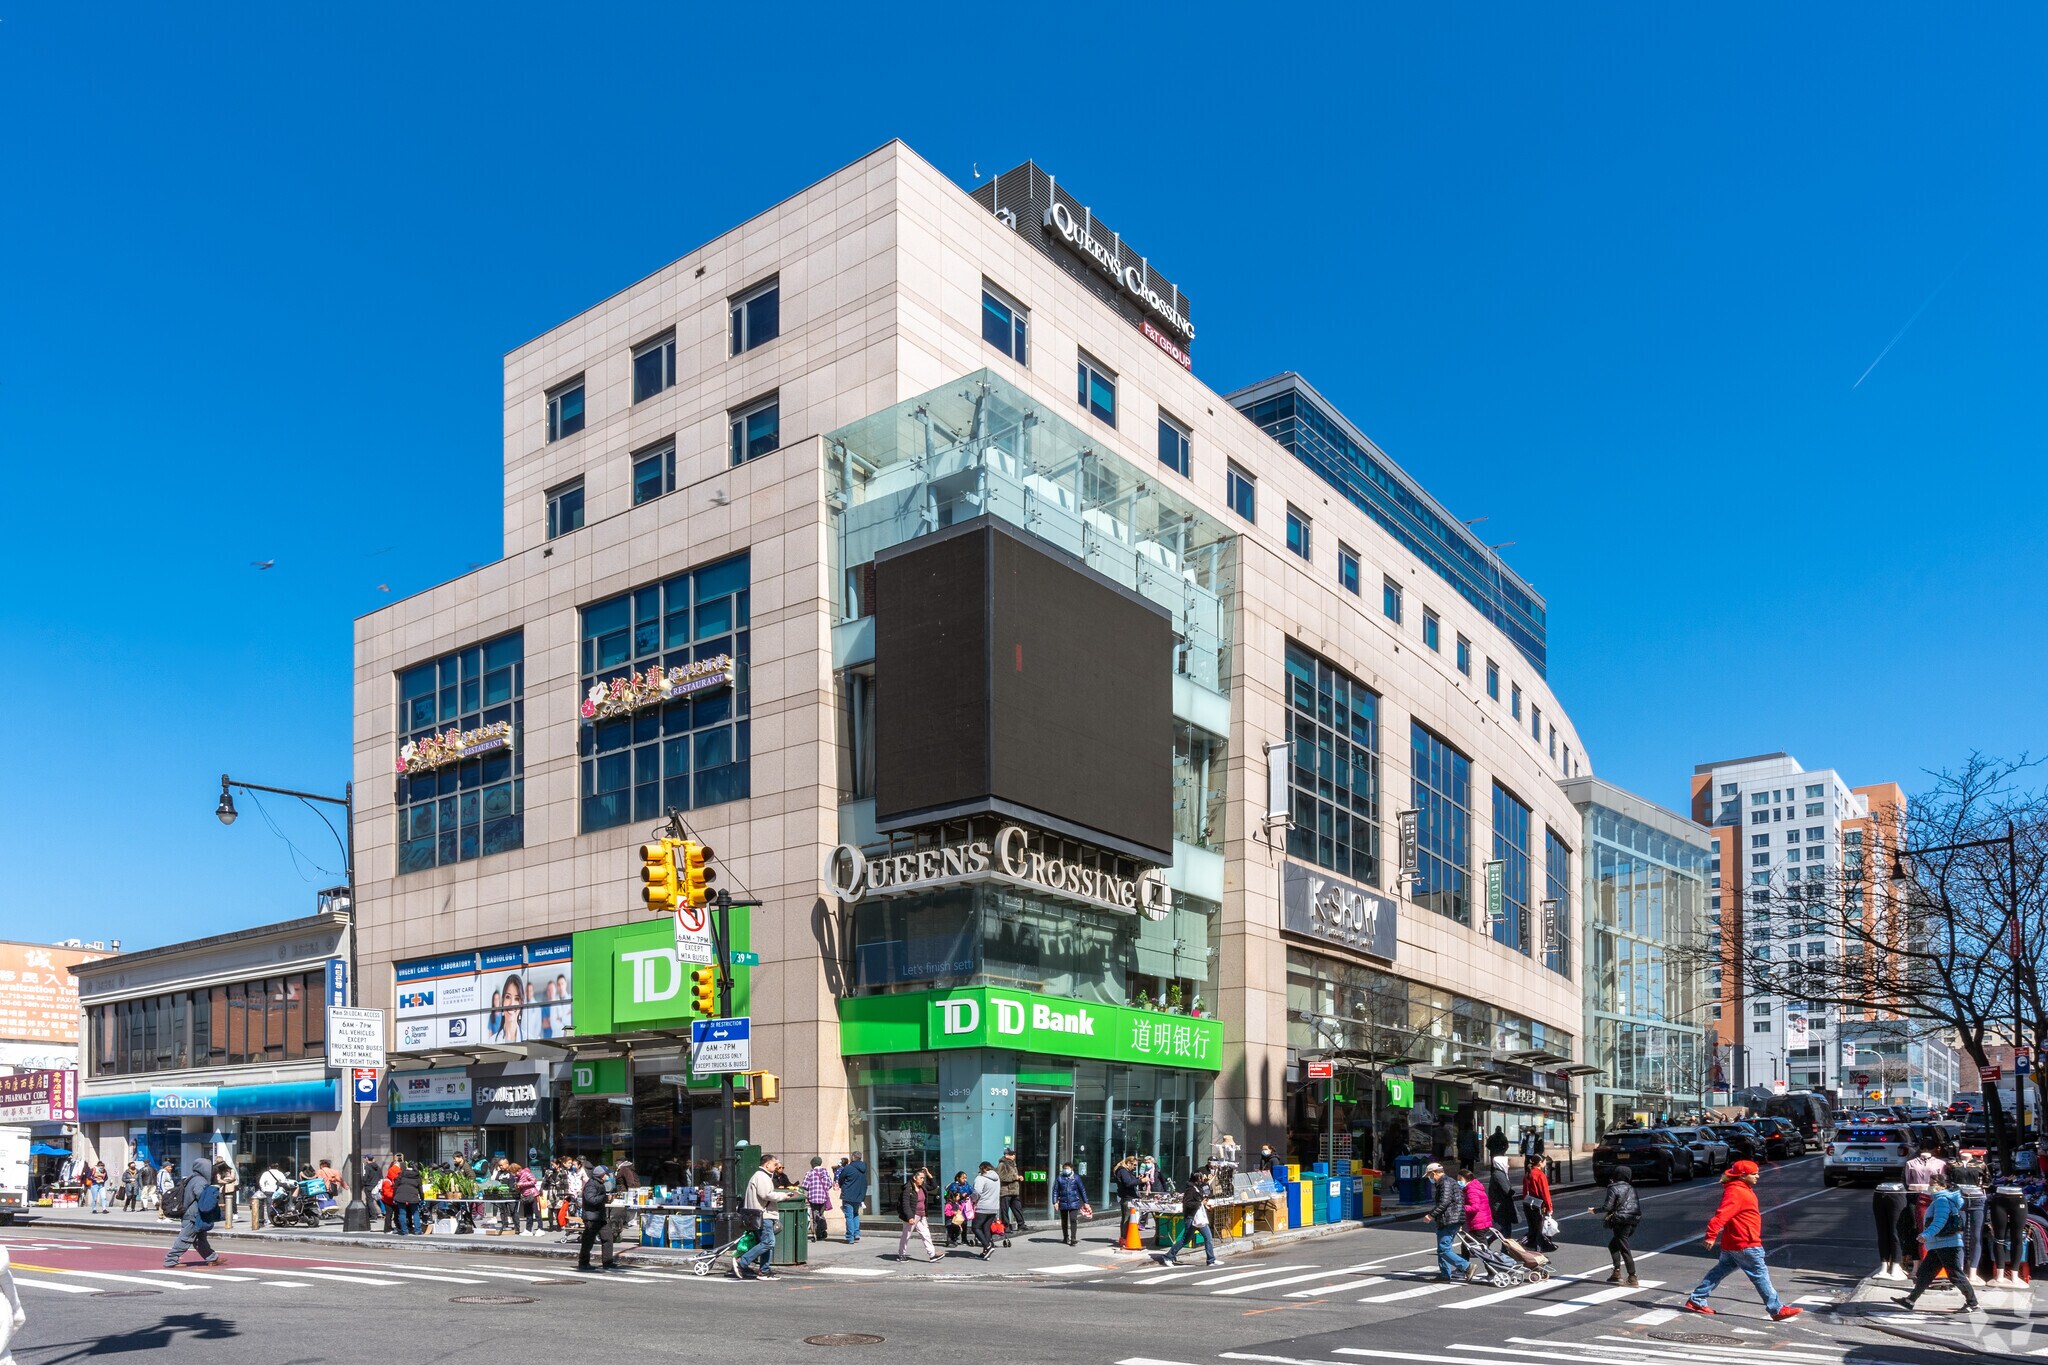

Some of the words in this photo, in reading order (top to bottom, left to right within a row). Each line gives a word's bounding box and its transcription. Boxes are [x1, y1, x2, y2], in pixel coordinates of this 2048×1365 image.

[1052, 203, 1121, 277] QUEENS
[1125, 267, 1195, 339] CROSSING
[1144, 323, 1159, 343] F&T
[1159, 337, 1191, 369] GROUP
[673, 674, 723, 696] RESTAURANT
[464, 739, 502, 756] RESTAURANT
[824, 841, 989, 903] QUEENS
[995, 826, 1137, 907] CROSSING
[535, 946, 554, 956] MEDICAL
[554, 944, 570, 953] BEAUTY
[685, 944, 703, 952] EXCEPT
[440, 960, 471, 970] LABORATORY
[486, 954, 516, 963] RADIOLOGY
[736, 953, 744, 962] 39
[399, 967, 417, 976] URGENT
[622, 948, 682, 1004] TD
[903, 965, 924, 975] Let's
[926, 960, 951, 973] finish
[935, 998, 980, 1035] TD
[990, 998, 1025, 1035] TD
[1033, 1003, 1095, 1036] Bank
[1131, 1018, 1210, 1060] 道明银行
[574, 1067, 593, 1087] TD
[5, 1092, 32, 1103] PHARMACY
[514, 1083, 537, 1100] TEA
[156, 1096, 212, 1109] citibank
[900, 1121, 921, 1131] ATM
